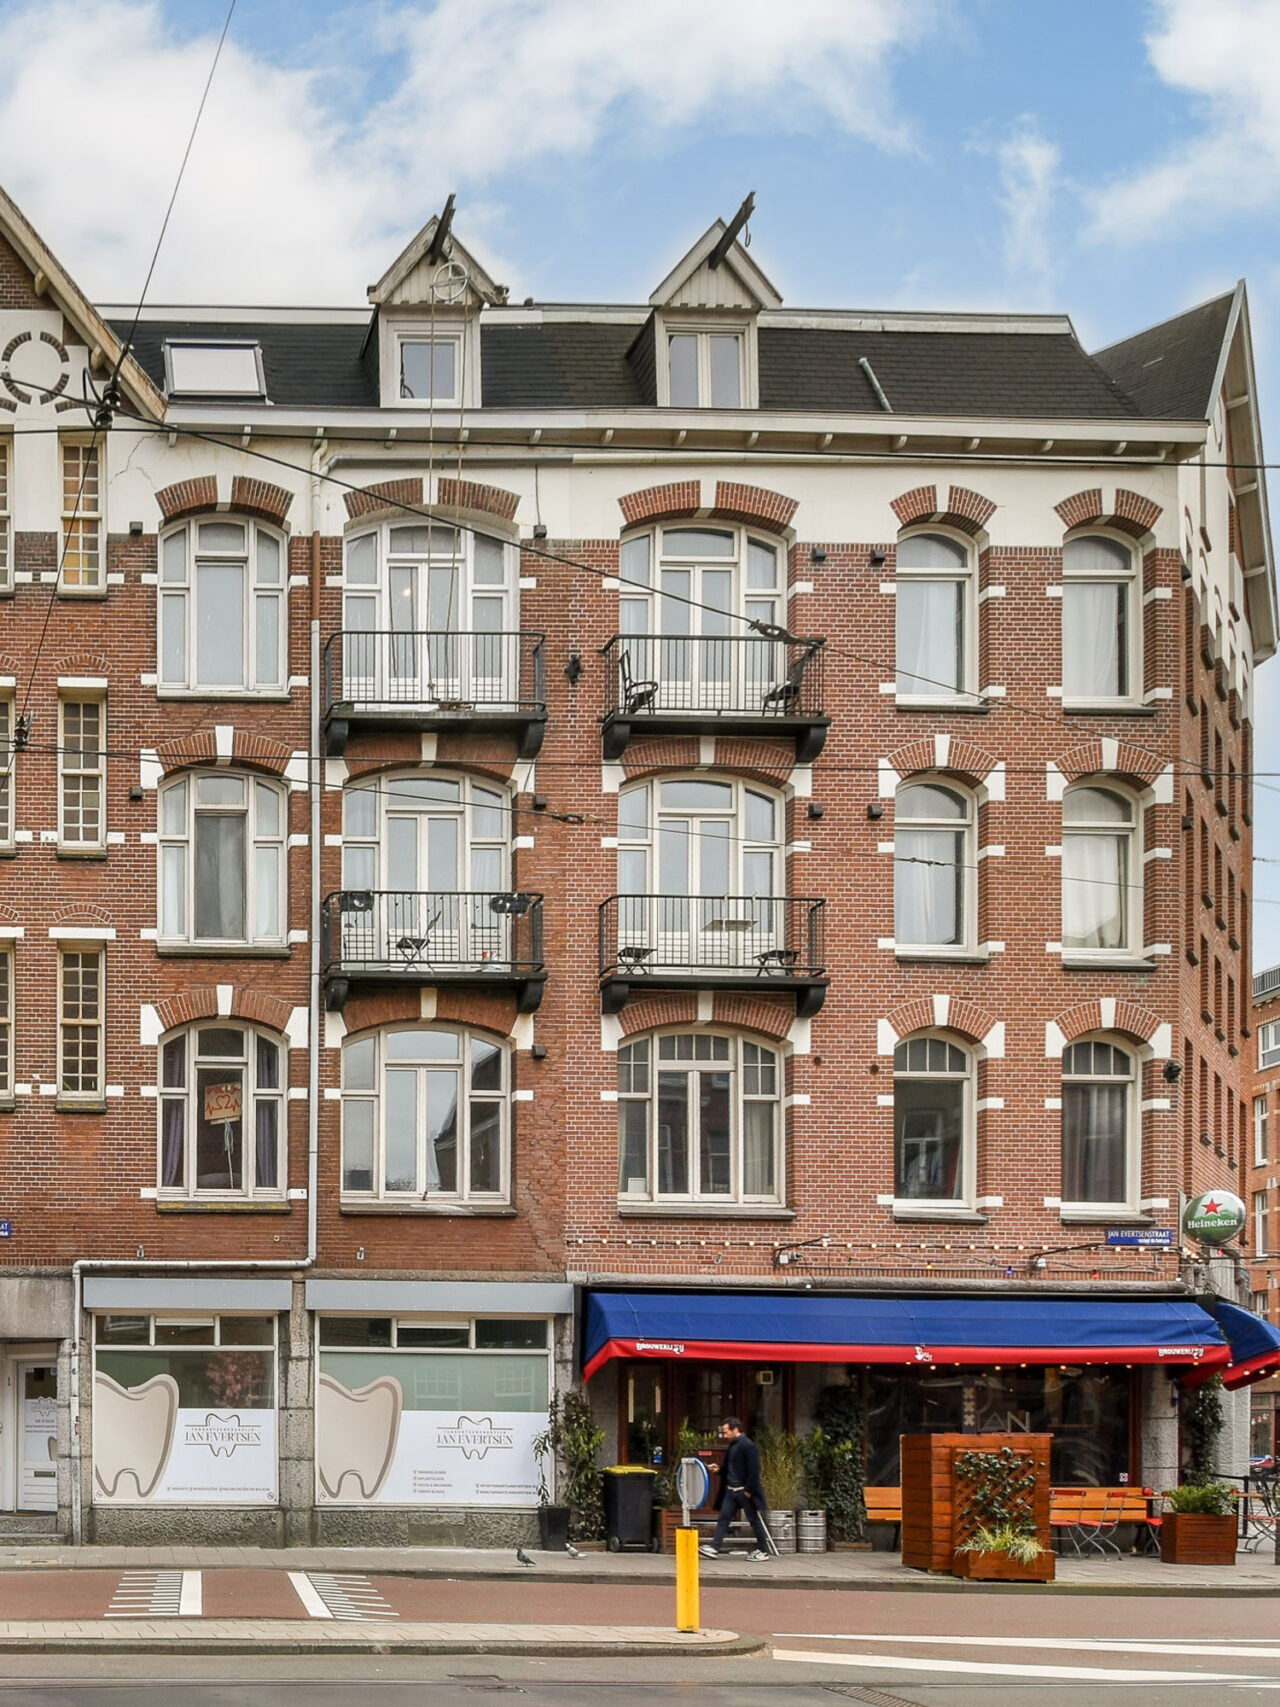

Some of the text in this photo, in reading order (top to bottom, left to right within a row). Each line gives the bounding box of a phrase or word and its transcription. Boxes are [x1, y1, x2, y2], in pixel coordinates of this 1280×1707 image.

[1187, 1218, 1238, 1229] Heineken
[1108, 1230, 1119, 1239] JAN
[185, 1432, 261, 1442] JAN EVERTSEN
[437, 1434, 513, 1445] JAN EVERTSEN
